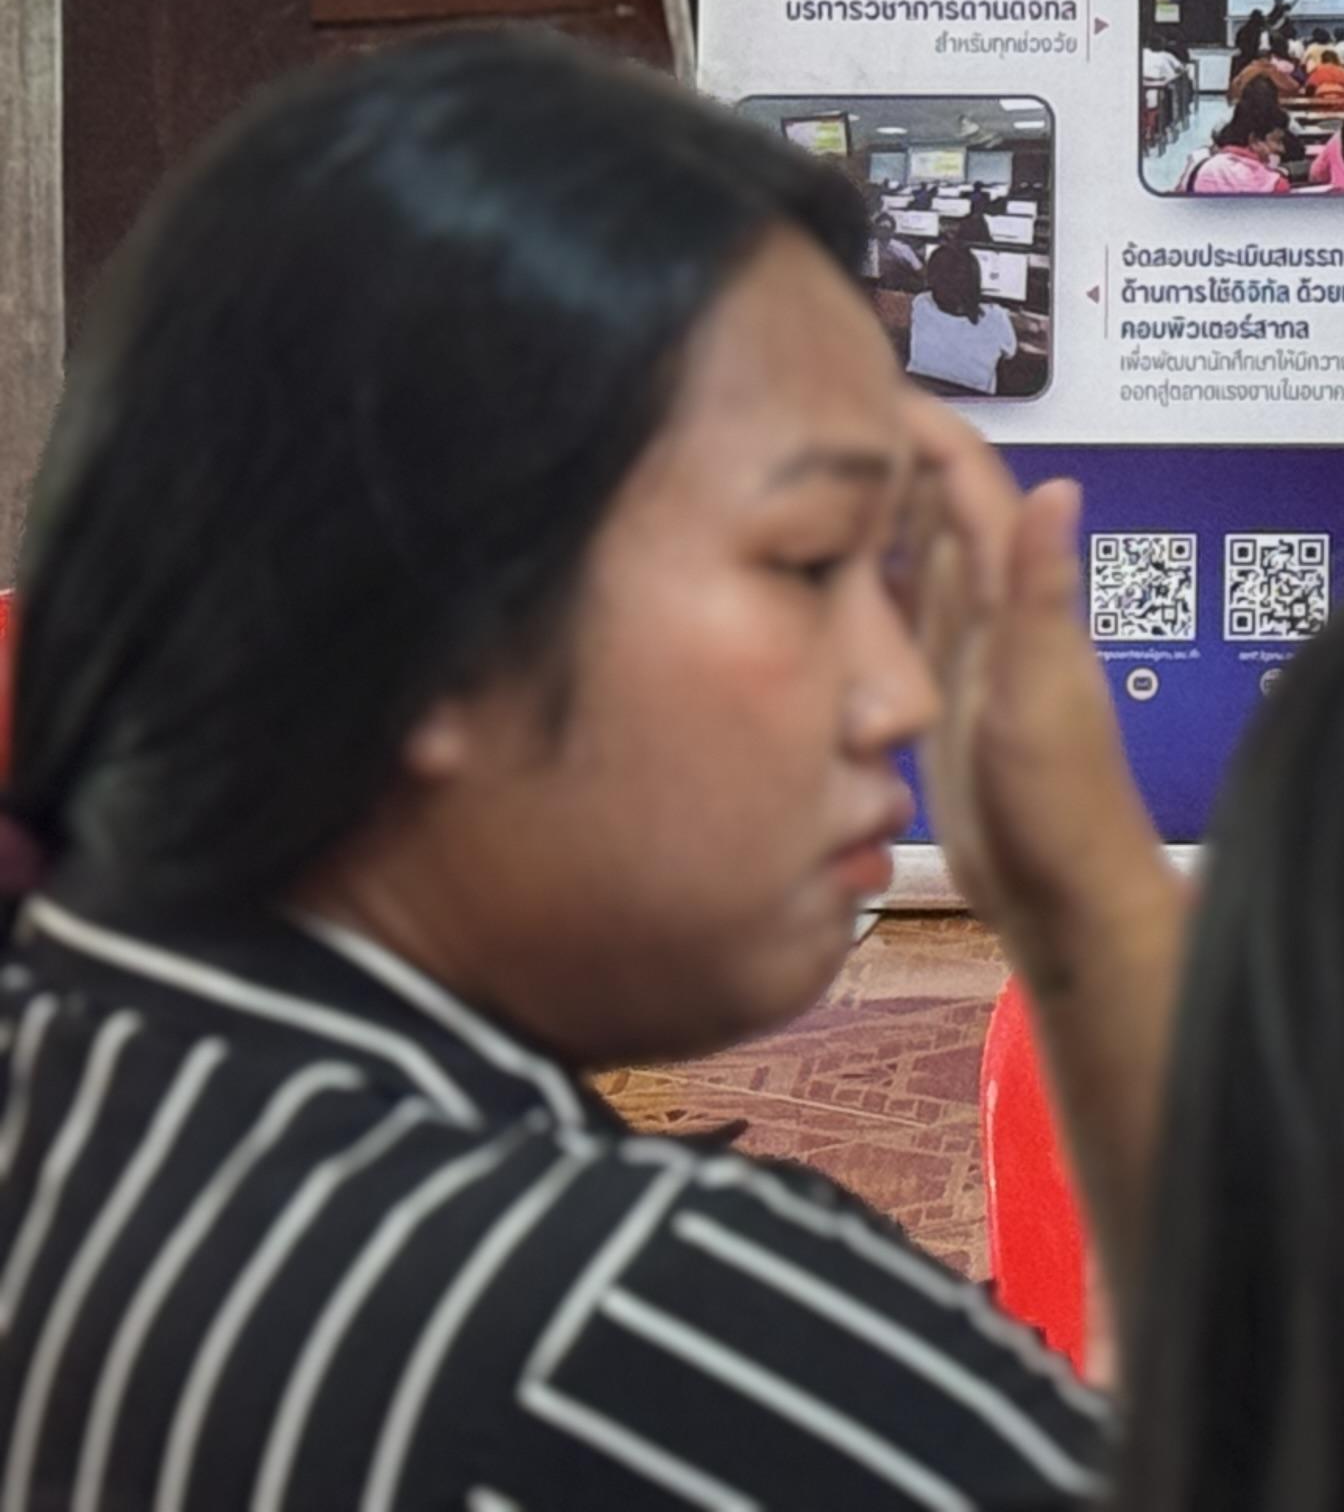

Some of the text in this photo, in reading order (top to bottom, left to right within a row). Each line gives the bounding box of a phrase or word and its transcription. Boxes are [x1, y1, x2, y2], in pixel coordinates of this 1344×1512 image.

[935, 30, 1078, 58] สำหรับทุกช่วงวัย
[1121, 276, 1291, 304] ด้านการใช้ดิจิทัล
[1120, 313, 1311, 340] คอมพิวเตอร์สากล
